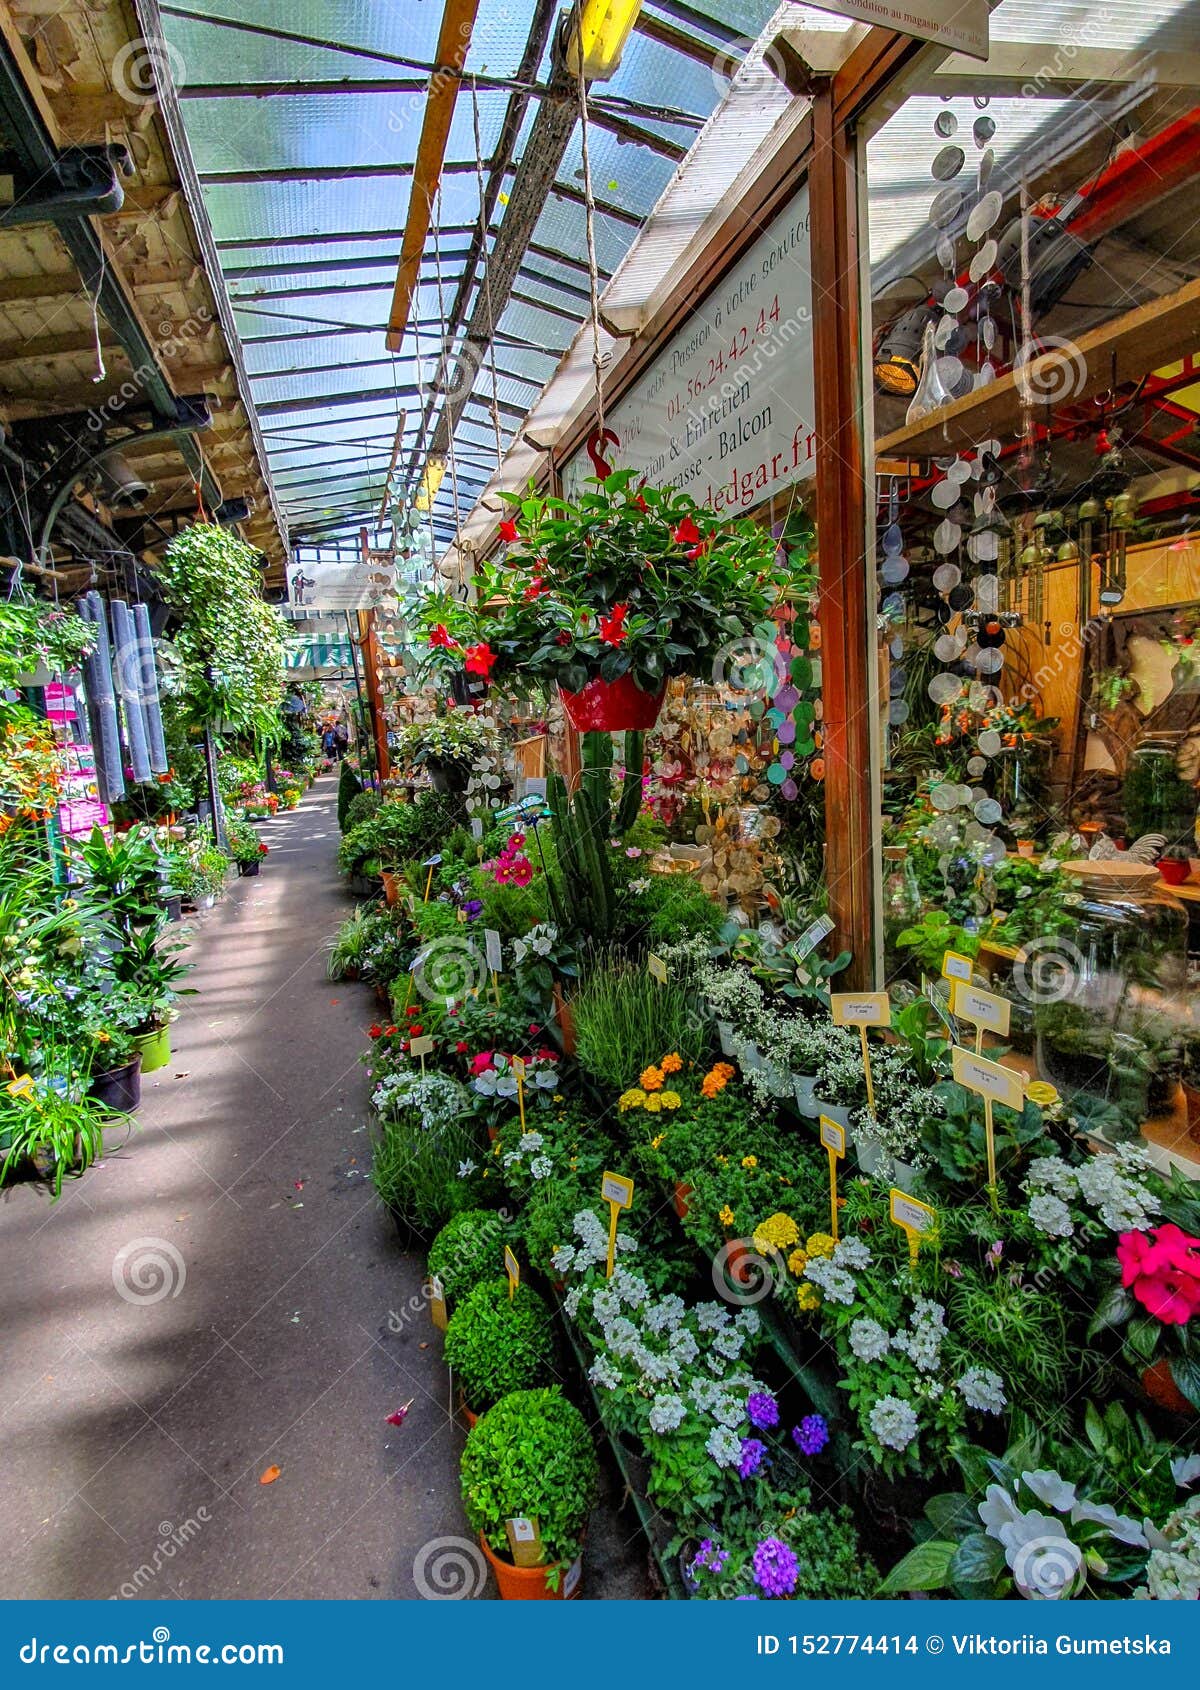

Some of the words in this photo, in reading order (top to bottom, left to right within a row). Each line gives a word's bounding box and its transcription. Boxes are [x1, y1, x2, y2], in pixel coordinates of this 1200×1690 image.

[891, 8, 901, 20] au
[903, 13, 939, 33] magasin
[667, 293, 780, 421] 01.56.24.42.44
[671, 325, 710, 375] Passion
[726, 272, 757, 316] votre
[656, 458, 702, 492] Trasse
[719, 405, 772, 460] Balcon
[670, 436, 680, 461] &
[686, 380, 750, 448] Entretien
